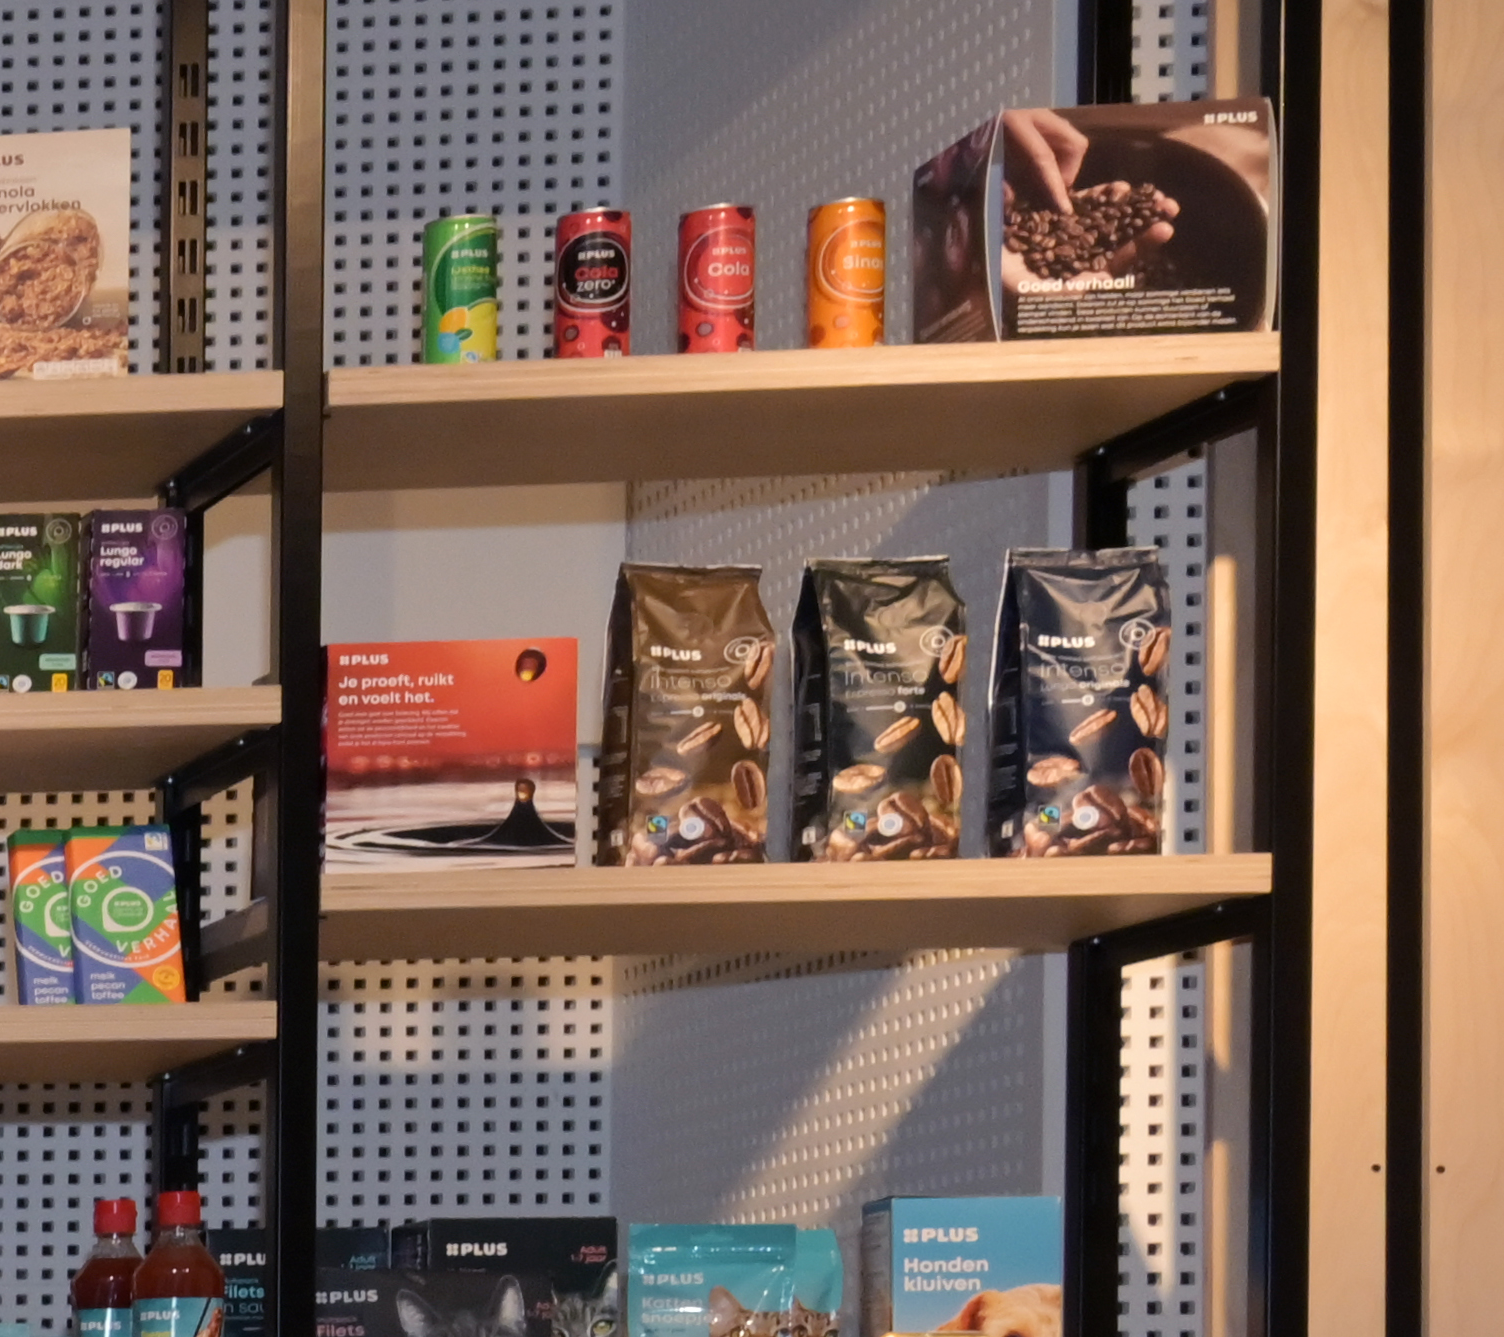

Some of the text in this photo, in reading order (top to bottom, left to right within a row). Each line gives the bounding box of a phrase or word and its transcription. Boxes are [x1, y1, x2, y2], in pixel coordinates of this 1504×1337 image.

[1217, 111, 1258, 123] PLUS
[588, 249, 615, 261] PLUS
[575, 265, 618, 280] Cola
[708, 262, 749, 277] Cola
[7, 527, 37, 537] PLUS
[111, 523, 142, 533] PLUS
[100, 545, 137, 556] Lungo
[100, 555, 144, 566] regular
[857, 640, 896, 654] PLUS
[1050, 636, 1095, 648] PLUS
[351, 654, 389, 665] PLUS
[663, 647, 701, 661] PLUS
[844, 669, 927, 685] Intenso
[1040, 663, 1125, 678] Intenso
[339, 673, 454, 690] Je proeft, ruikt
[339, 691, 435, 705] en voelt het.
[20, 870, 64, 913] GOED
[77, 866, 123, 908] GOED
[115, 890, 178, 955] VERHAAL
[922, 1228, 978, 1242] PLUS
[461, 1243, 507, 1256] PLUS
[904, 1257, 988, 1272] Honden
[658, 1273, 703, 1285] PLUS
[904, 1276, 980, 1291] kluiven
[330, 1289, 378, 1303] PLUS
[316, 1323, 365, 1337] Filets
